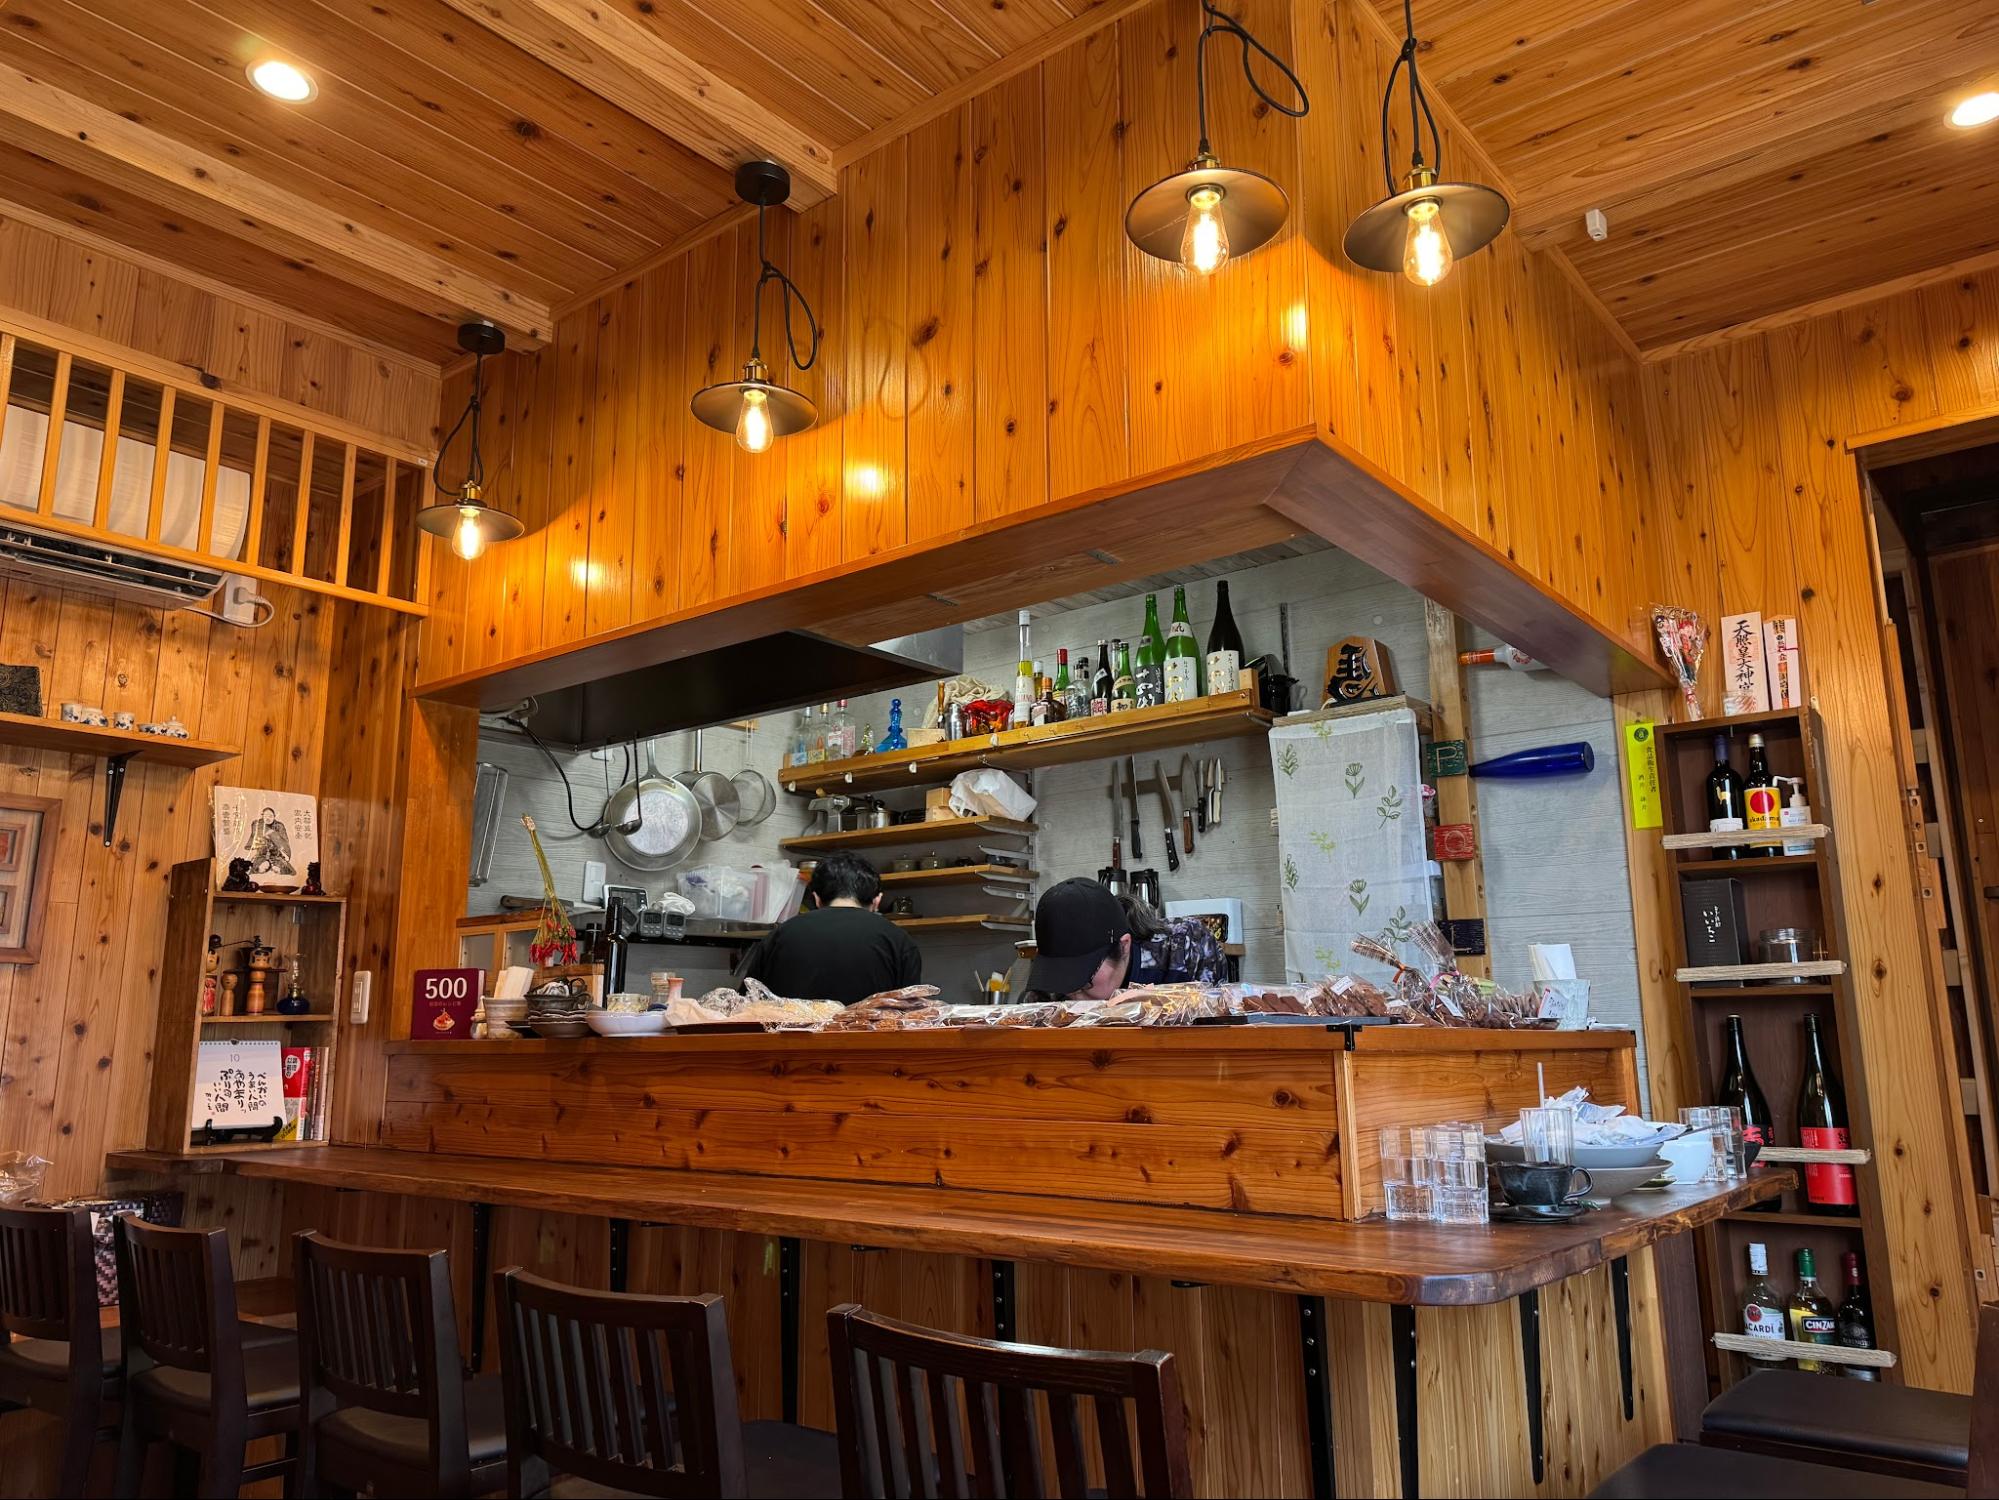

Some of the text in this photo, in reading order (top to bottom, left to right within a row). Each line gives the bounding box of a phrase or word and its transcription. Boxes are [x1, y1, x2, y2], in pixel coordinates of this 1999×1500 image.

[1437, 746, 1458, 773] P
[1702, 910, 1716, 943] いいちこ
[425, 977, 468, 999] 500
[230, 1054, 240, 1062] 10
